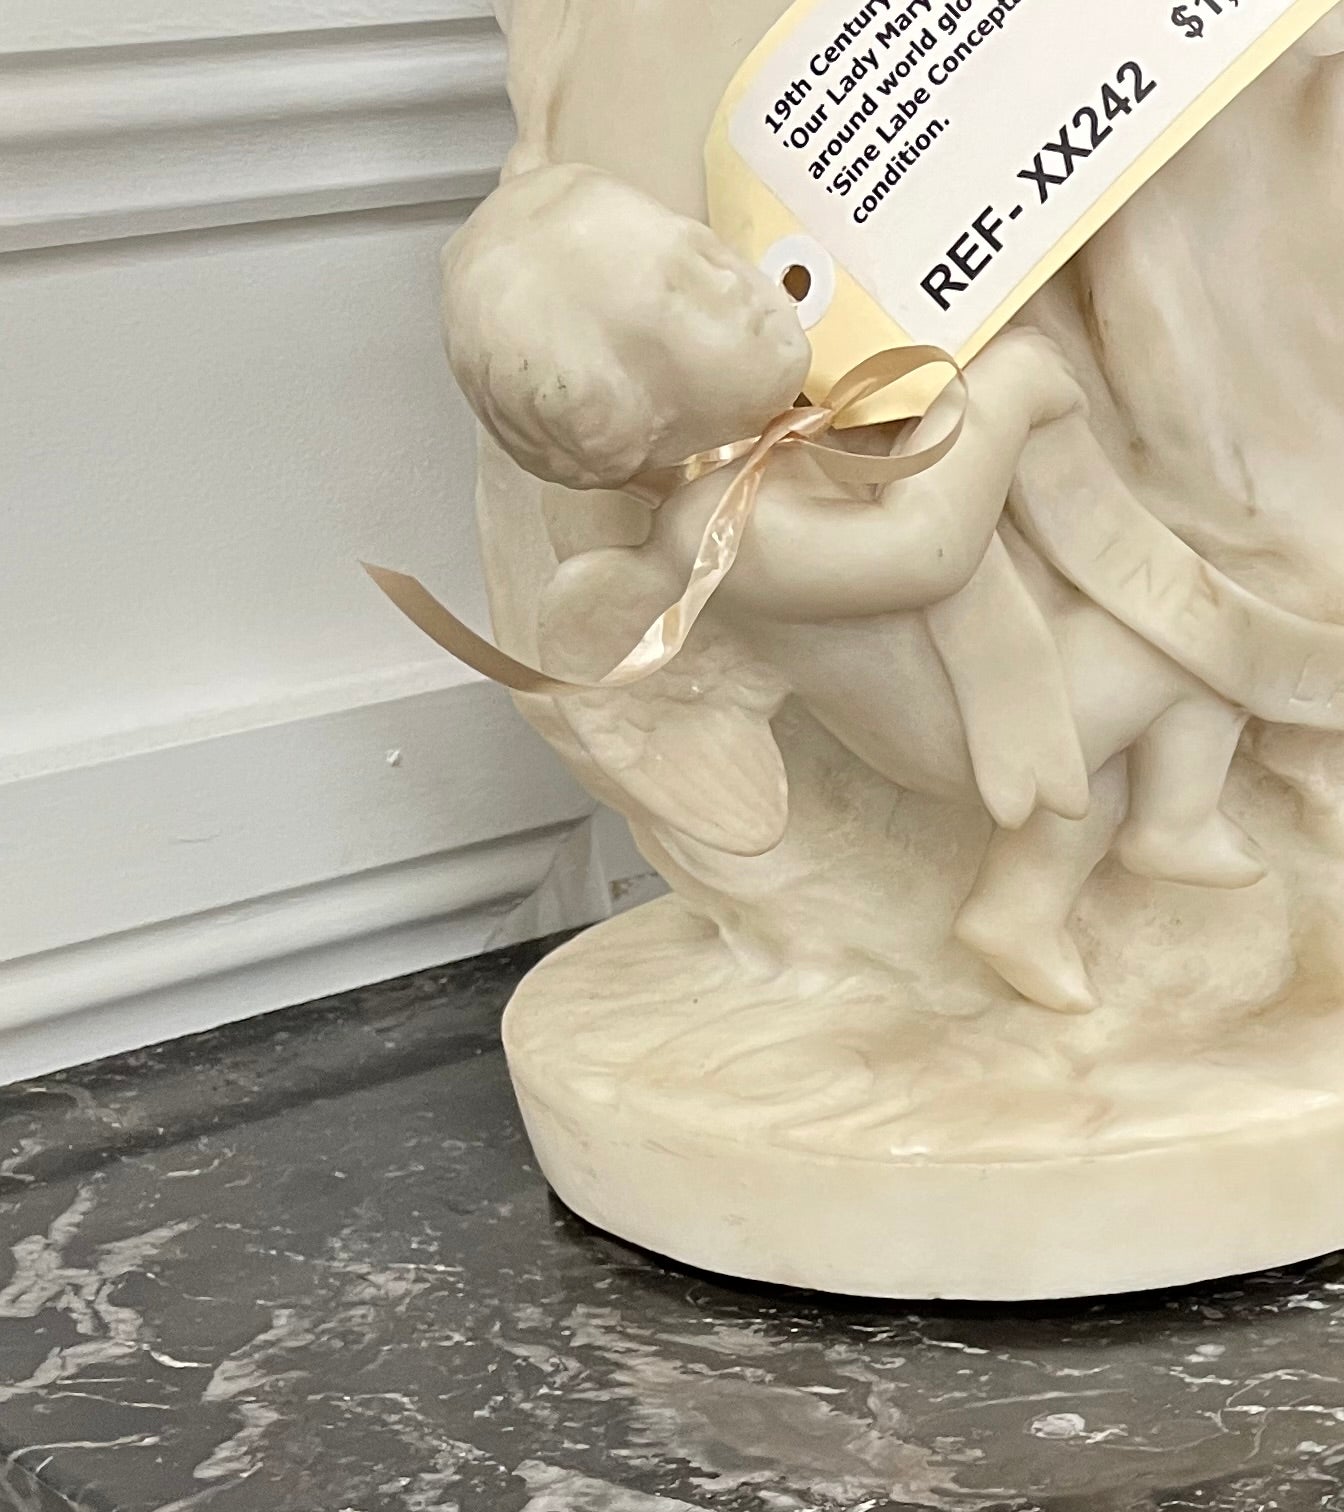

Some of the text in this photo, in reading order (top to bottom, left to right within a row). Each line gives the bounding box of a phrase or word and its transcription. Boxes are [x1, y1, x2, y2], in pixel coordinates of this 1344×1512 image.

[765, 79, 813, 134] 19th
[783, 104, 828, 149] 'Our
[826, 48, 879, 105] Lady
[808, 93, 879, 180] around
[876, 28, 938, 96] world
[826, 144, 881, 196] 'Sine
[875, 87, 931, 144] Labe
[853, 118, 950, 224] condition.
[919, 204, 1023, 312] REF-
[1016, 61, 1157, 204] XX242
